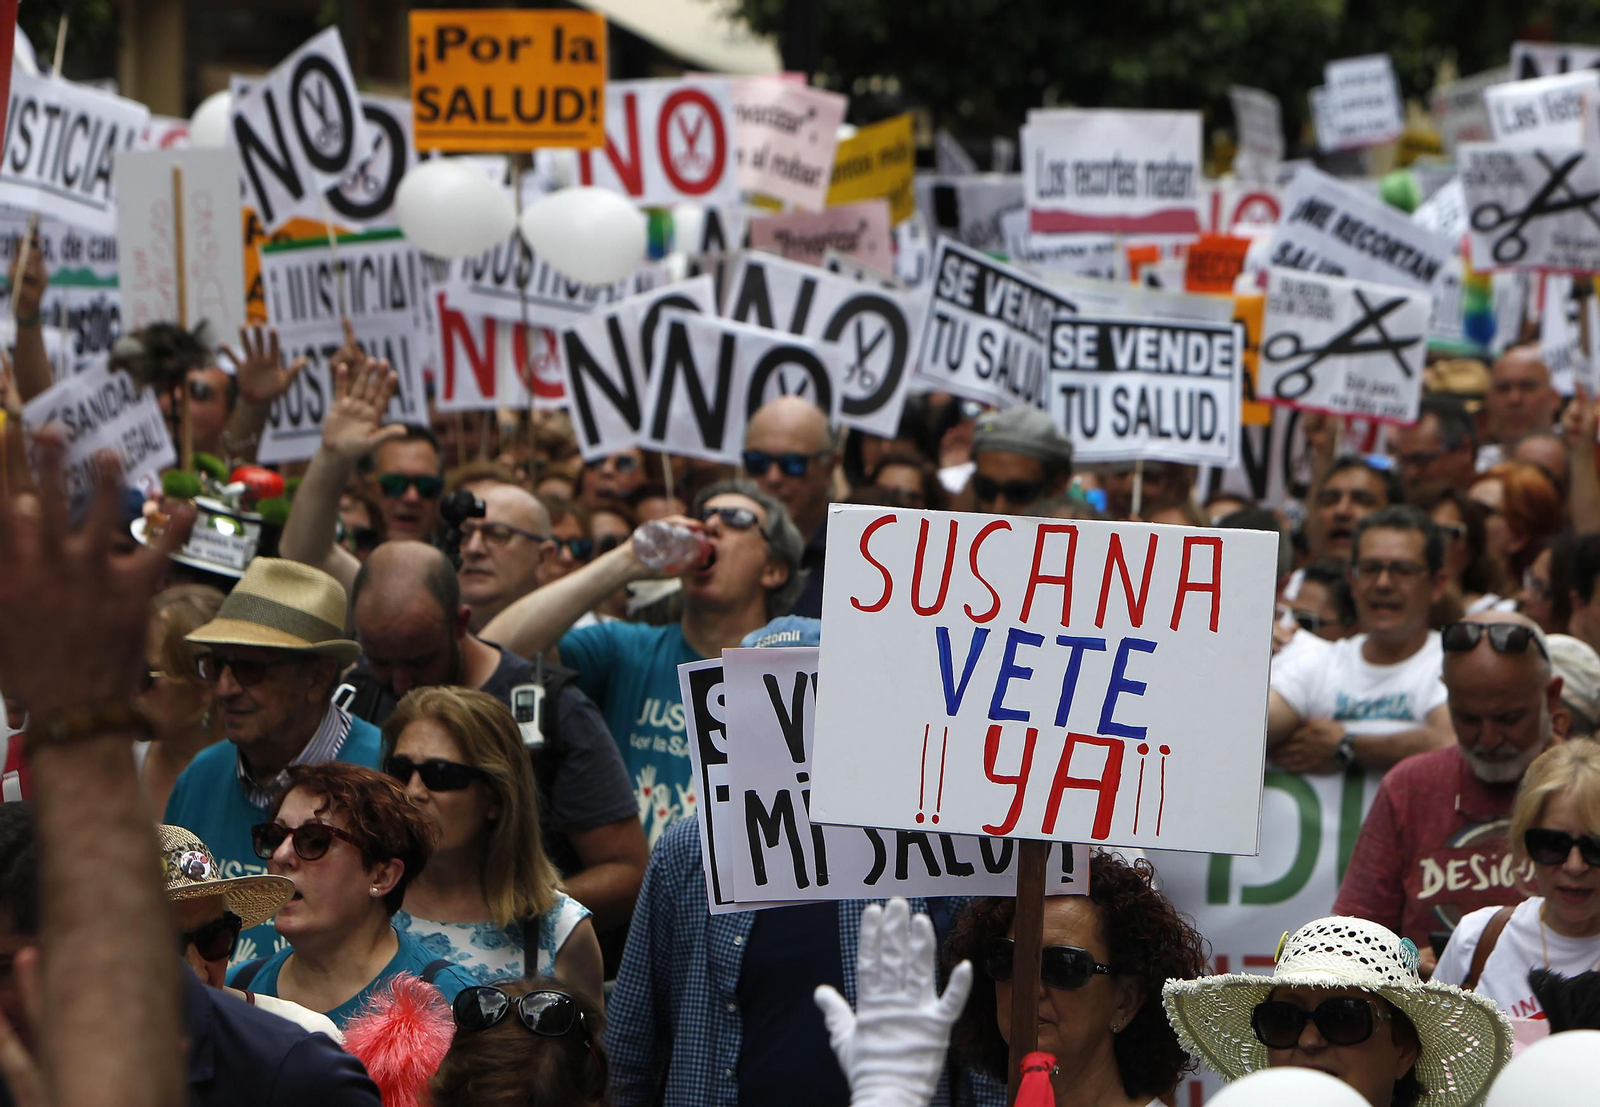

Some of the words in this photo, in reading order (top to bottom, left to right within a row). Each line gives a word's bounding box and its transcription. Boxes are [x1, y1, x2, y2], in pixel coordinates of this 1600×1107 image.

[554, 26, 598, 64] la
[416, 86, 598, 124] SALUD!
[233, 54, 354, 224] NO
[580, 88, 727, 198] NO
[931, 311, 971, 373] TU
[1052, 323, 1100, 371] SE
[1109, 325, 1233, 376] VENDE
[1060, 384, 1100, 439] TU
[850, 514, 1224, 633] SUSANA
[936, 626, 1159, 740] VETE
